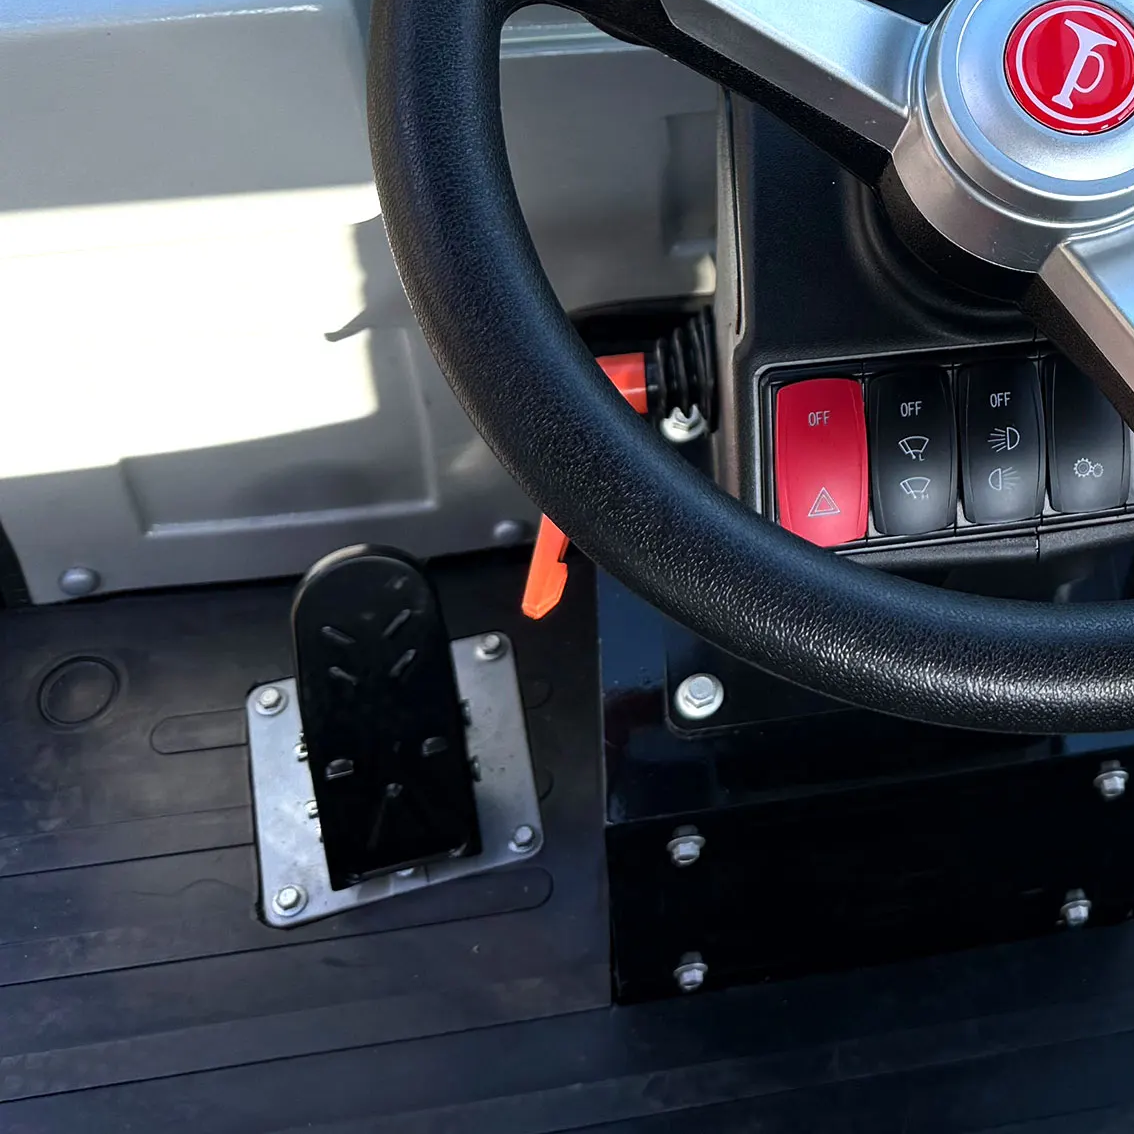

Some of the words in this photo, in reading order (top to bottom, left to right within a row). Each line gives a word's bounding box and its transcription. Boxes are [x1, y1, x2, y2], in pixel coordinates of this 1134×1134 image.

[990, 391, 1012, 409] OFF
[900, 401, 924, 418] OFF
[808, 410, 831, 427] OFF
